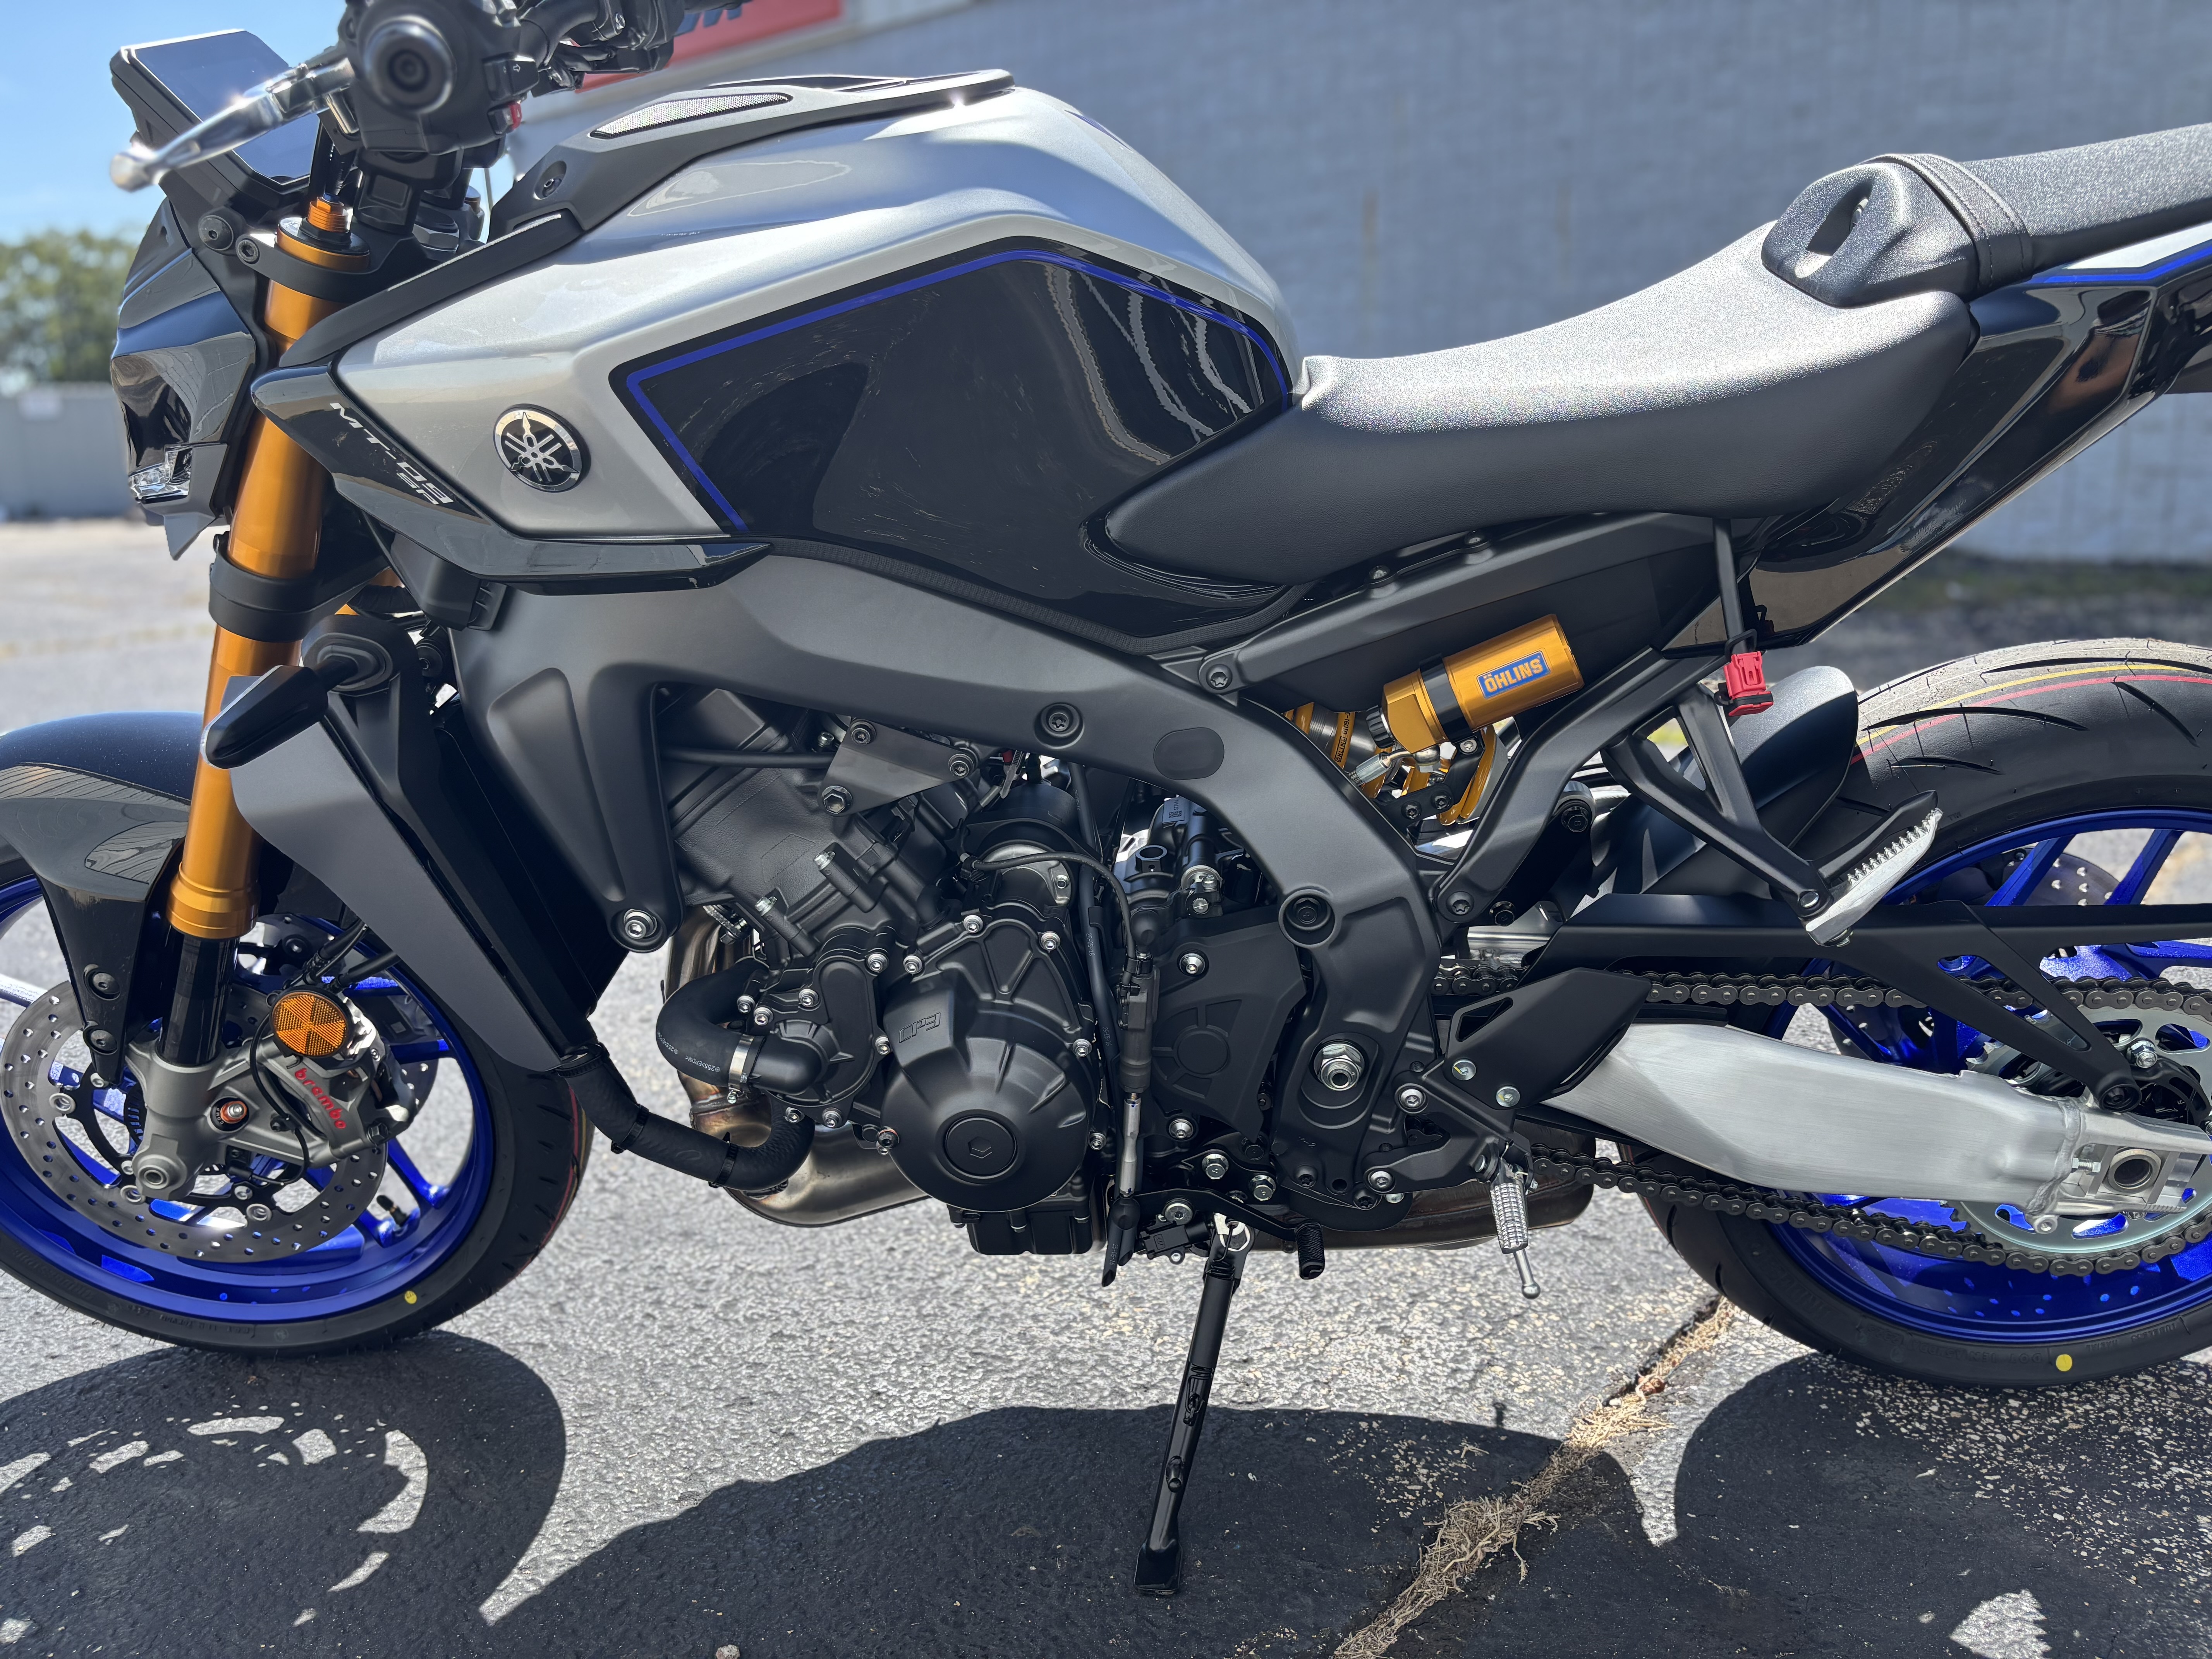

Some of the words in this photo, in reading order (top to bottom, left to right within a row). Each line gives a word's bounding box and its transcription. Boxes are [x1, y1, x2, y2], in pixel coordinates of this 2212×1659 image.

[330, 403, 454, 503] MT-09
[397, 473, 439, 505] SP
[1483, 659, 1543, 692] ÖHLINS
[1086, 933, 1094, 956] 25-05-16
[899, 1012, 941, 1043] CP3
[295, 1068, 346, 1130] brembo
